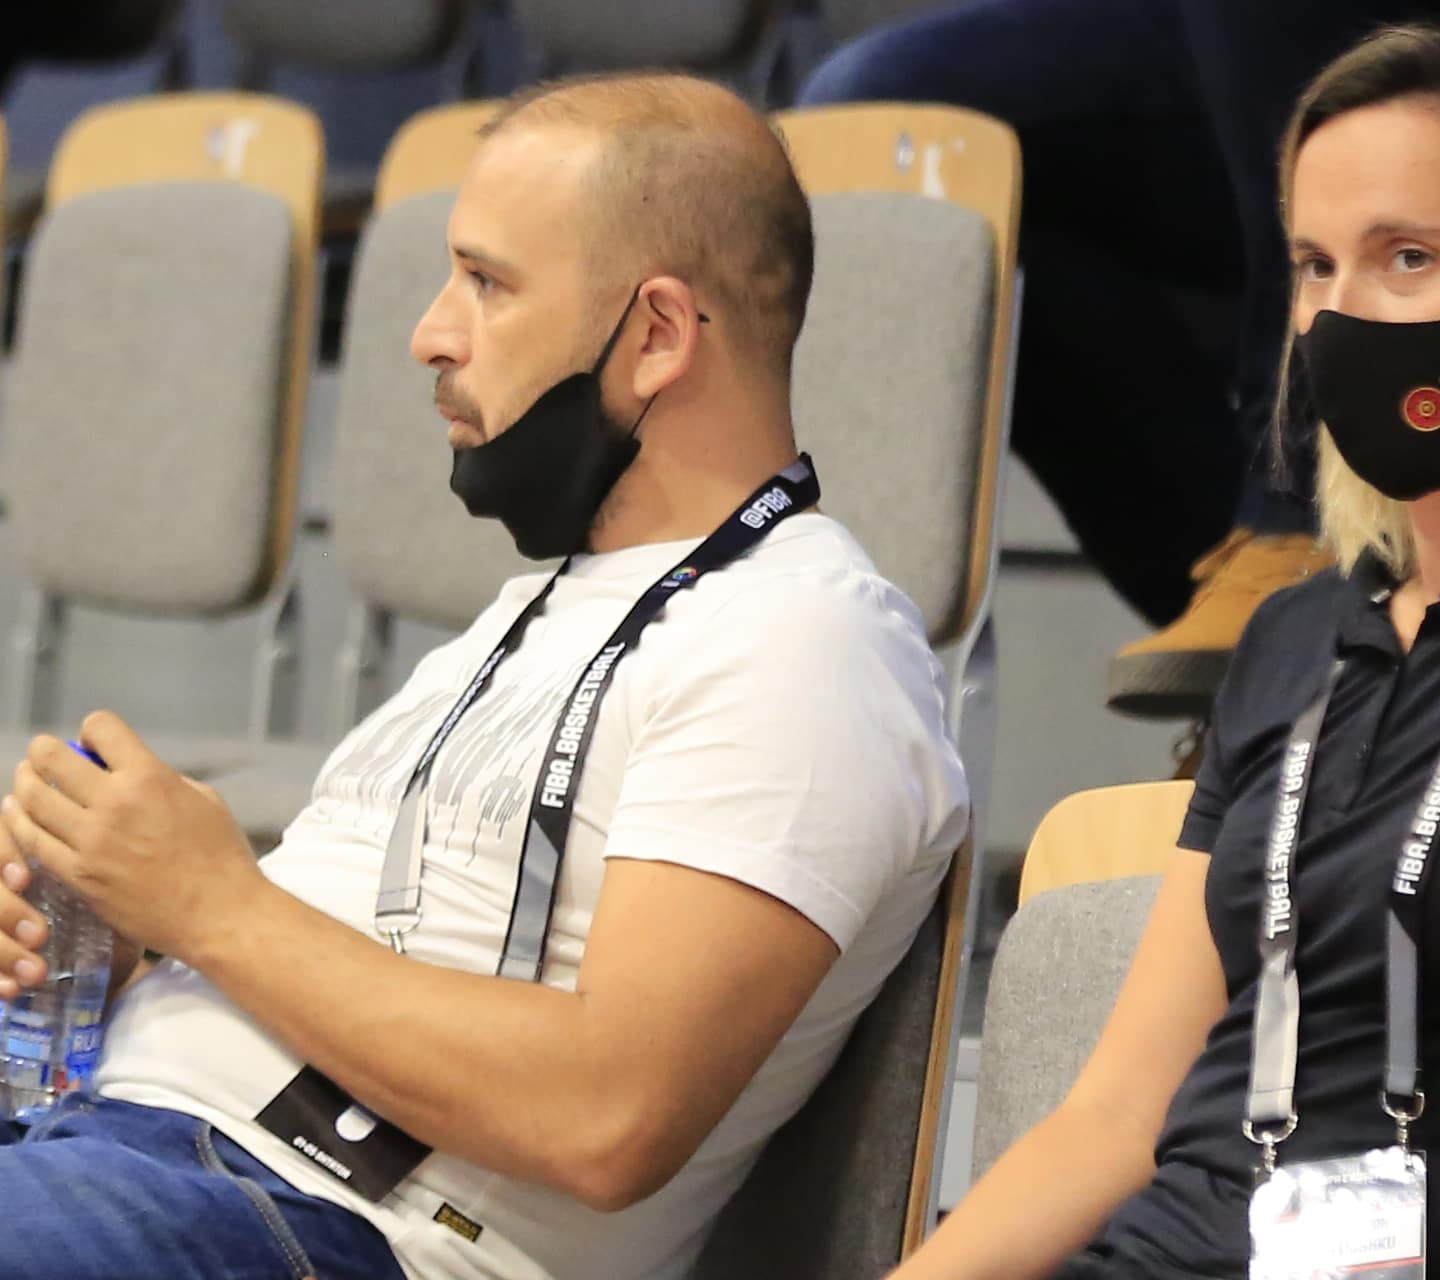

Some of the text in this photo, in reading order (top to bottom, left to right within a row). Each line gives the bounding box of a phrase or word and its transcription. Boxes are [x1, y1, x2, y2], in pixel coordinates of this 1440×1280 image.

[740, 487, 793, 529] @FIBA
[540, 641, 626, 809] FIBA.BASKETBALL
[1265, 741, 1311, 940] FIBA.BASKETBALL
